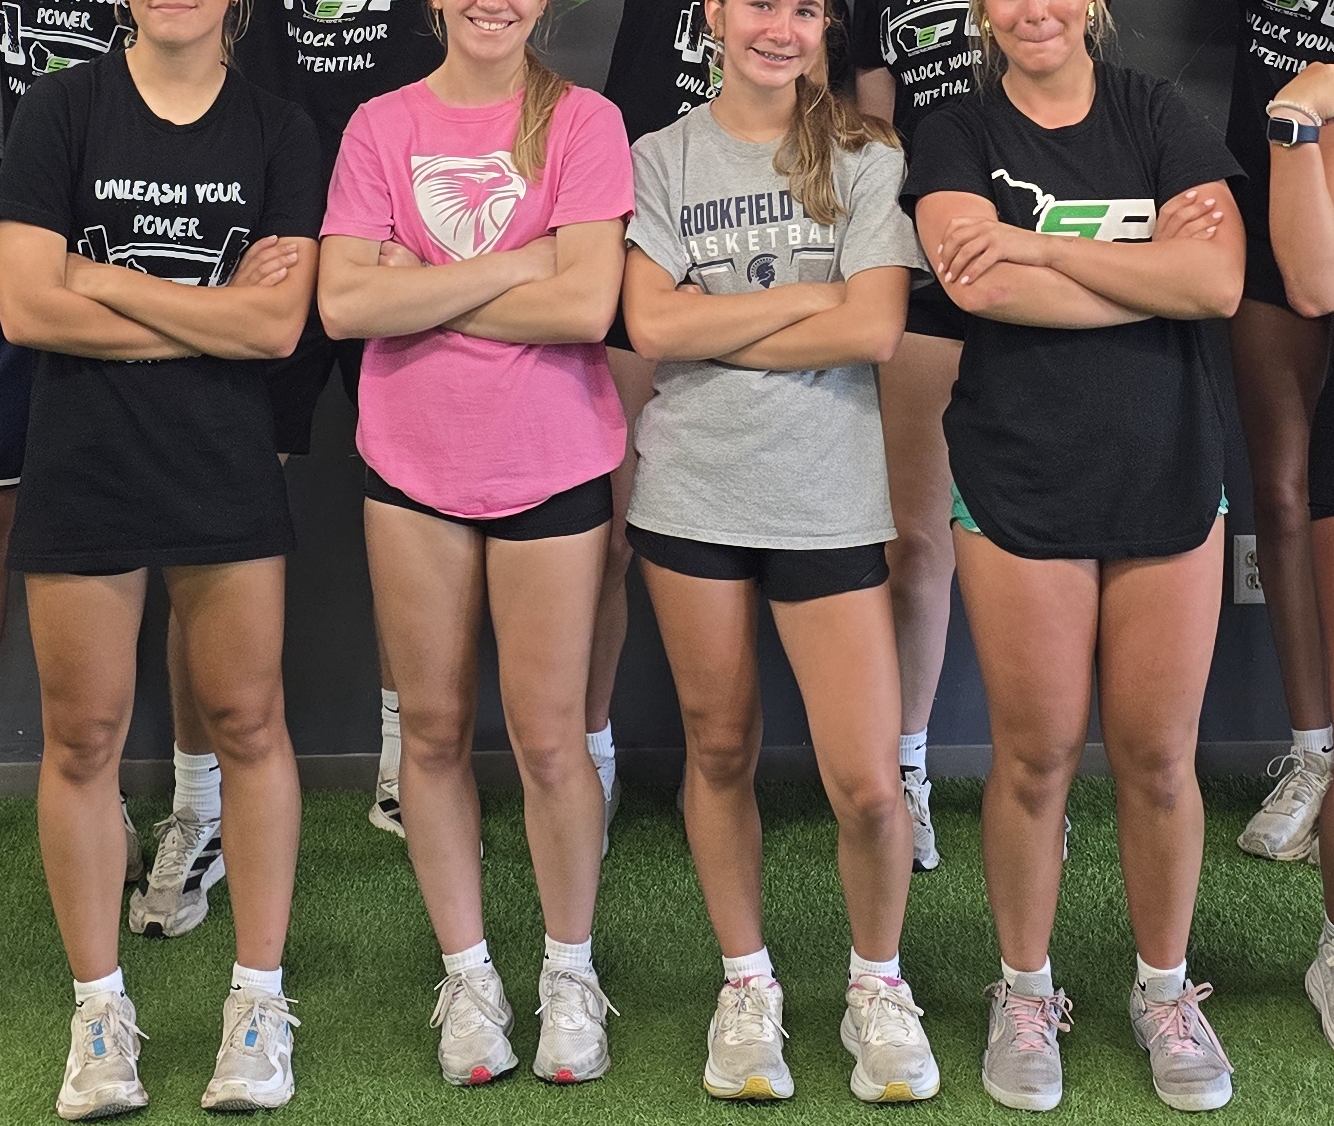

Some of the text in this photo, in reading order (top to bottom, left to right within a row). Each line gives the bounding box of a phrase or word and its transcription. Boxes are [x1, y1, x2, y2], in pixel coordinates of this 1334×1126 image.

[37, 7, 94, 31] POWER
[1245, 8, 1291, 44] LOCK
[287, 22, 388, 47] ULOCK YOUR
[297, 49, 376, 73] TENTIAL
[900, 49, 983, 86] NLOCK YOUR
[94, 179, 247, 206] UNLEASH YOUR
[680, 189, 794, 237] ROOKFIELD
[133, 214, 204, 240] POWER
[683, 222, 836, 265] ASKETBAL
